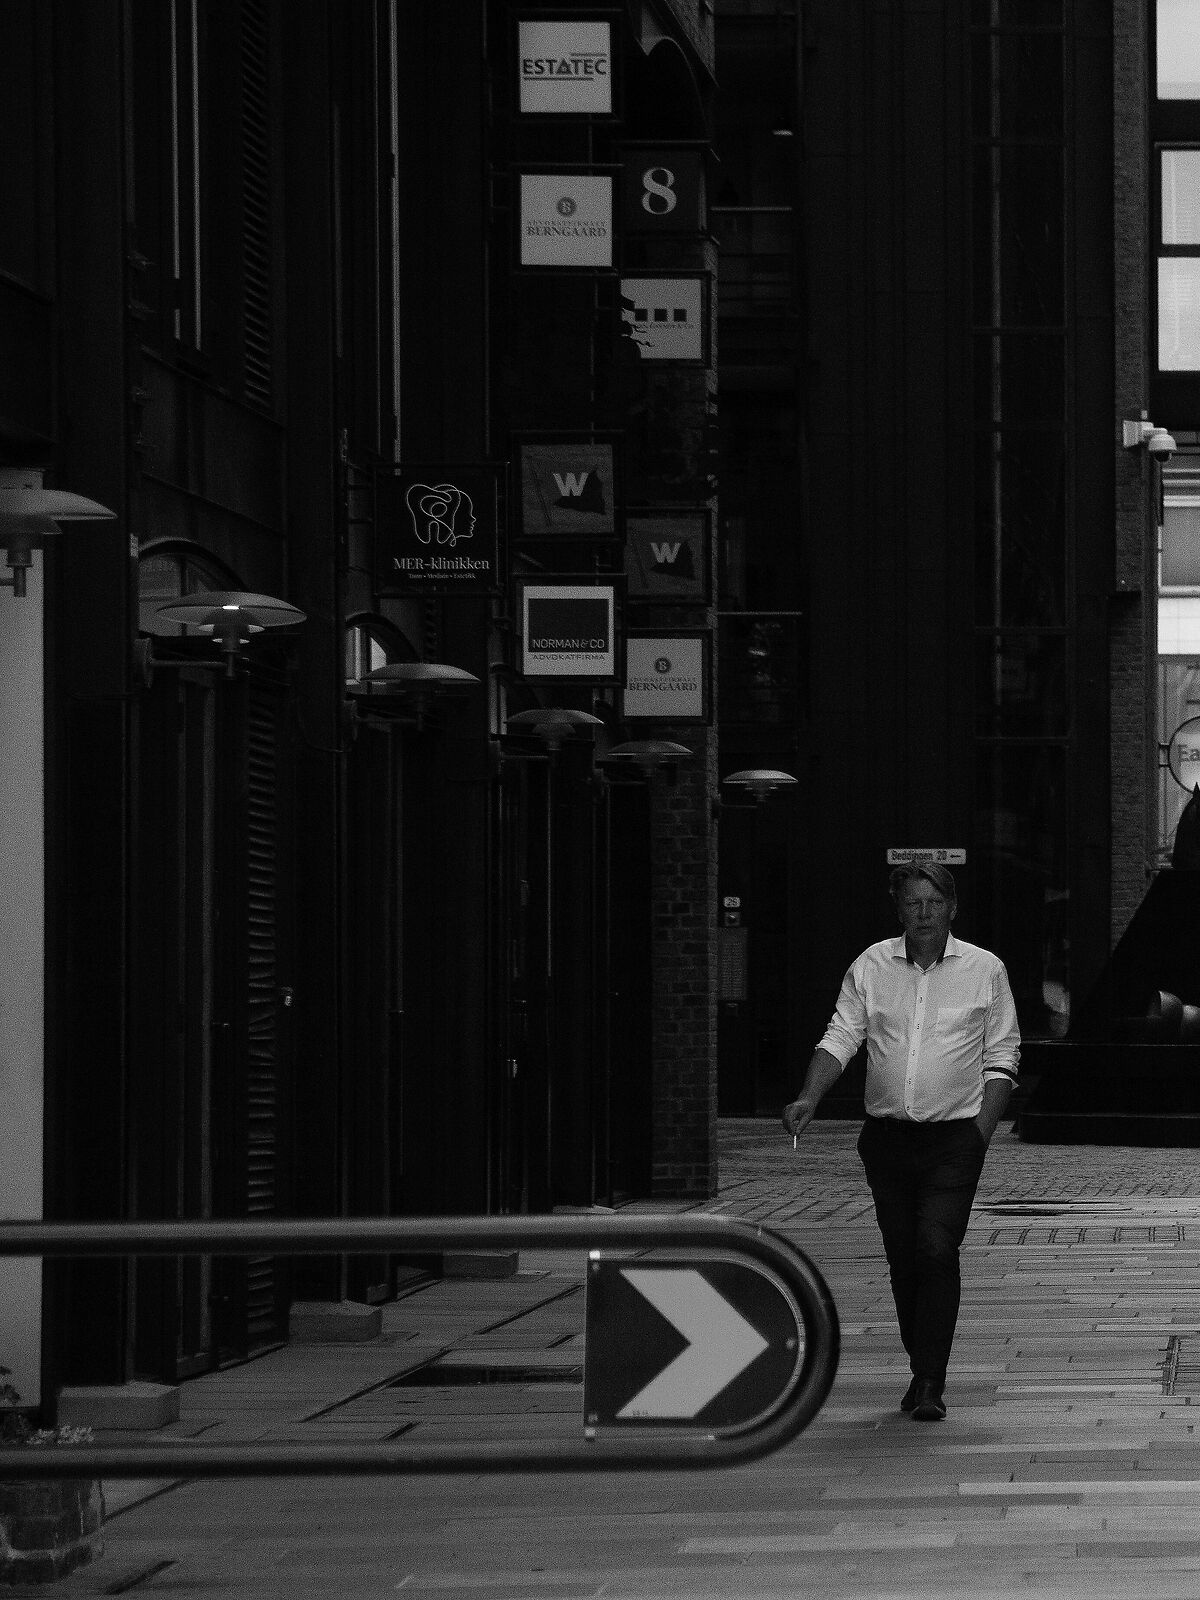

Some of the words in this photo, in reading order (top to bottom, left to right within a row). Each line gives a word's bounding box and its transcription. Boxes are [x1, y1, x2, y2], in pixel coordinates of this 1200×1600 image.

[523, 59, 607, 75] ESTATEC
[641, 166, 677, 215] 8
[525, 226, 606, 236] BERNGAARD
[393, 557, 490, 570] MER-klinikken
[629, 682, 697, 691] BERNGAARD
